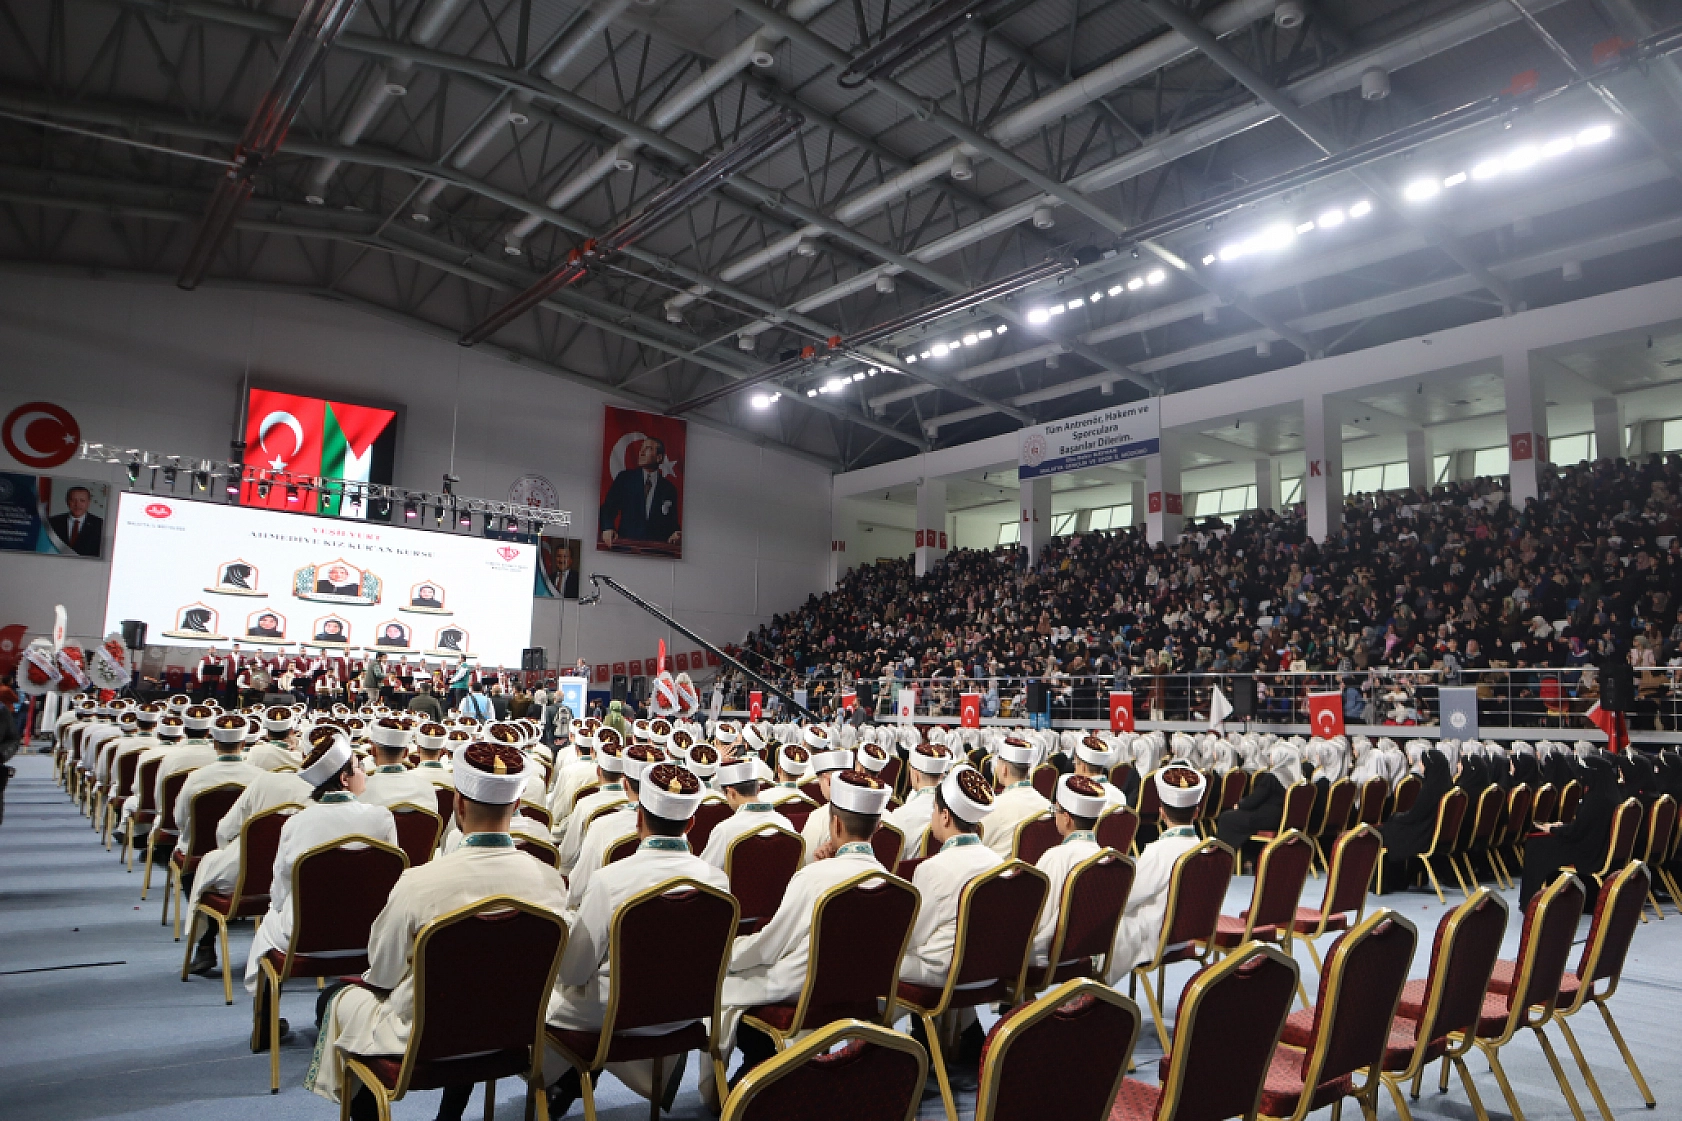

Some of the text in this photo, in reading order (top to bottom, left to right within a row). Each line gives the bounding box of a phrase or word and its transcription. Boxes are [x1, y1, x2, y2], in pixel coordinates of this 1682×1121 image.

[1046, 405, 1149, 435] Tüm Antrenör, Hakem ve
[1072, 424, 1118, 440] Sporculara
[1059, 440, 1095, 455] Başarılar
[1310, 460, 1321, 477] K
[1023, 509, 1030, 522] L
